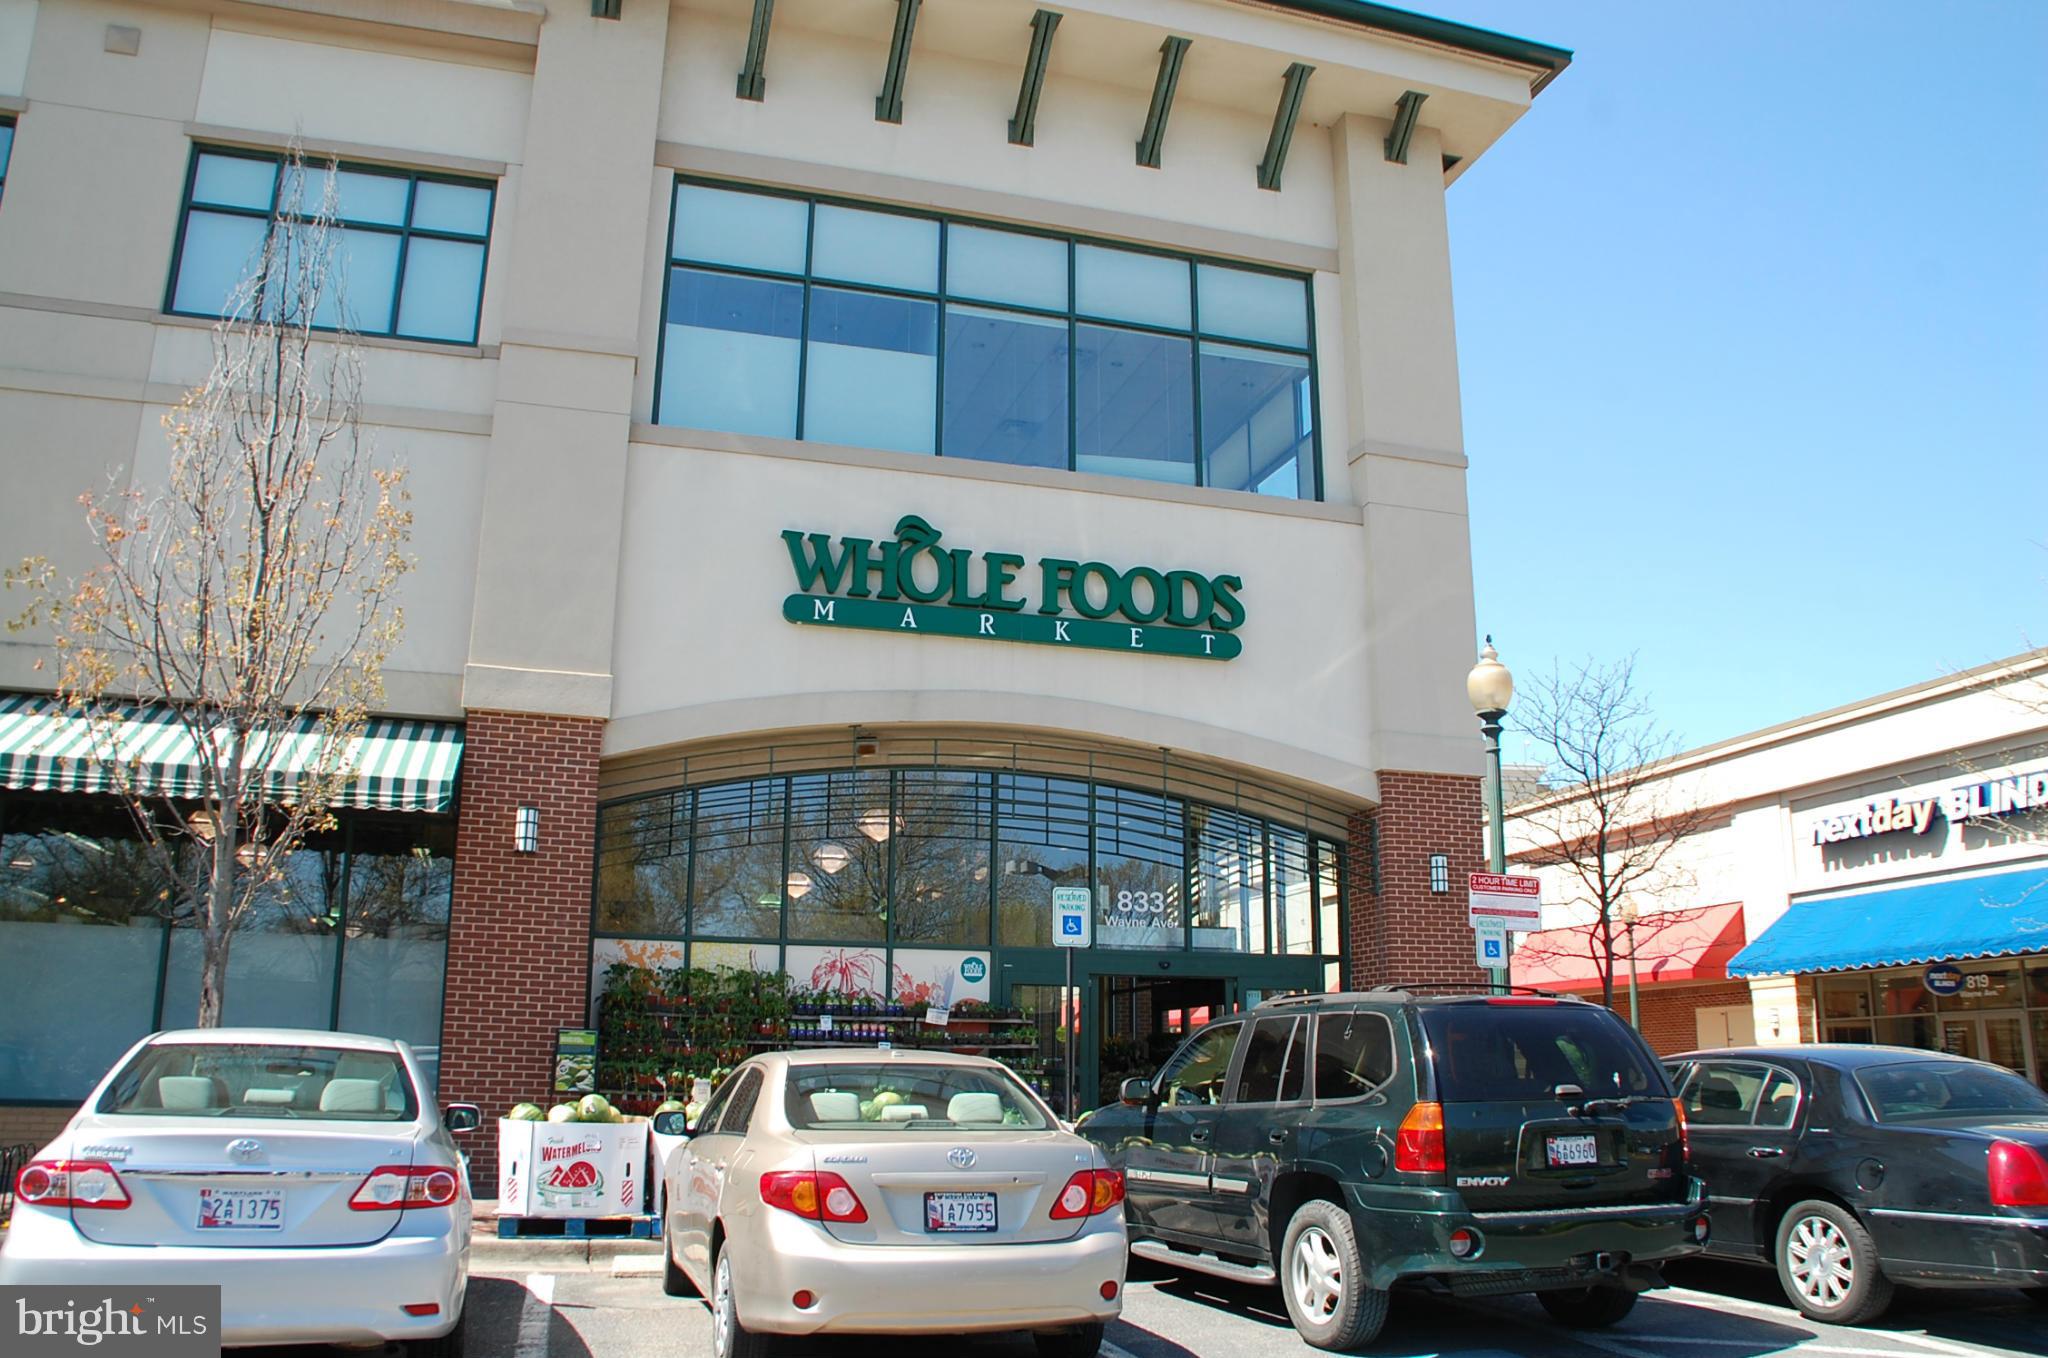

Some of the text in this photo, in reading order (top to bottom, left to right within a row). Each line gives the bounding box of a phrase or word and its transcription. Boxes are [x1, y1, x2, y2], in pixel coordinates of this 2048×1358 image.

[781, 515, 1246, 631] WHOLE FOODS
[813, 599, 1217, 654] MARKET
[1472, 876, 1538, 888] 2 HOUR TIME LIMIT
[1056, 894, 1087, 902] RESERVED
[1117, 890, 1164, 913] 833
[1058, 903, 1086, 911] PARKING
[1104, 915, 1147, 929] Wayne
[1966, 974, 1989, 988] 819
[541, 1139, 602, 1162] WATERMEL
[1456, 1176, 1510, 1187] ENVOY
